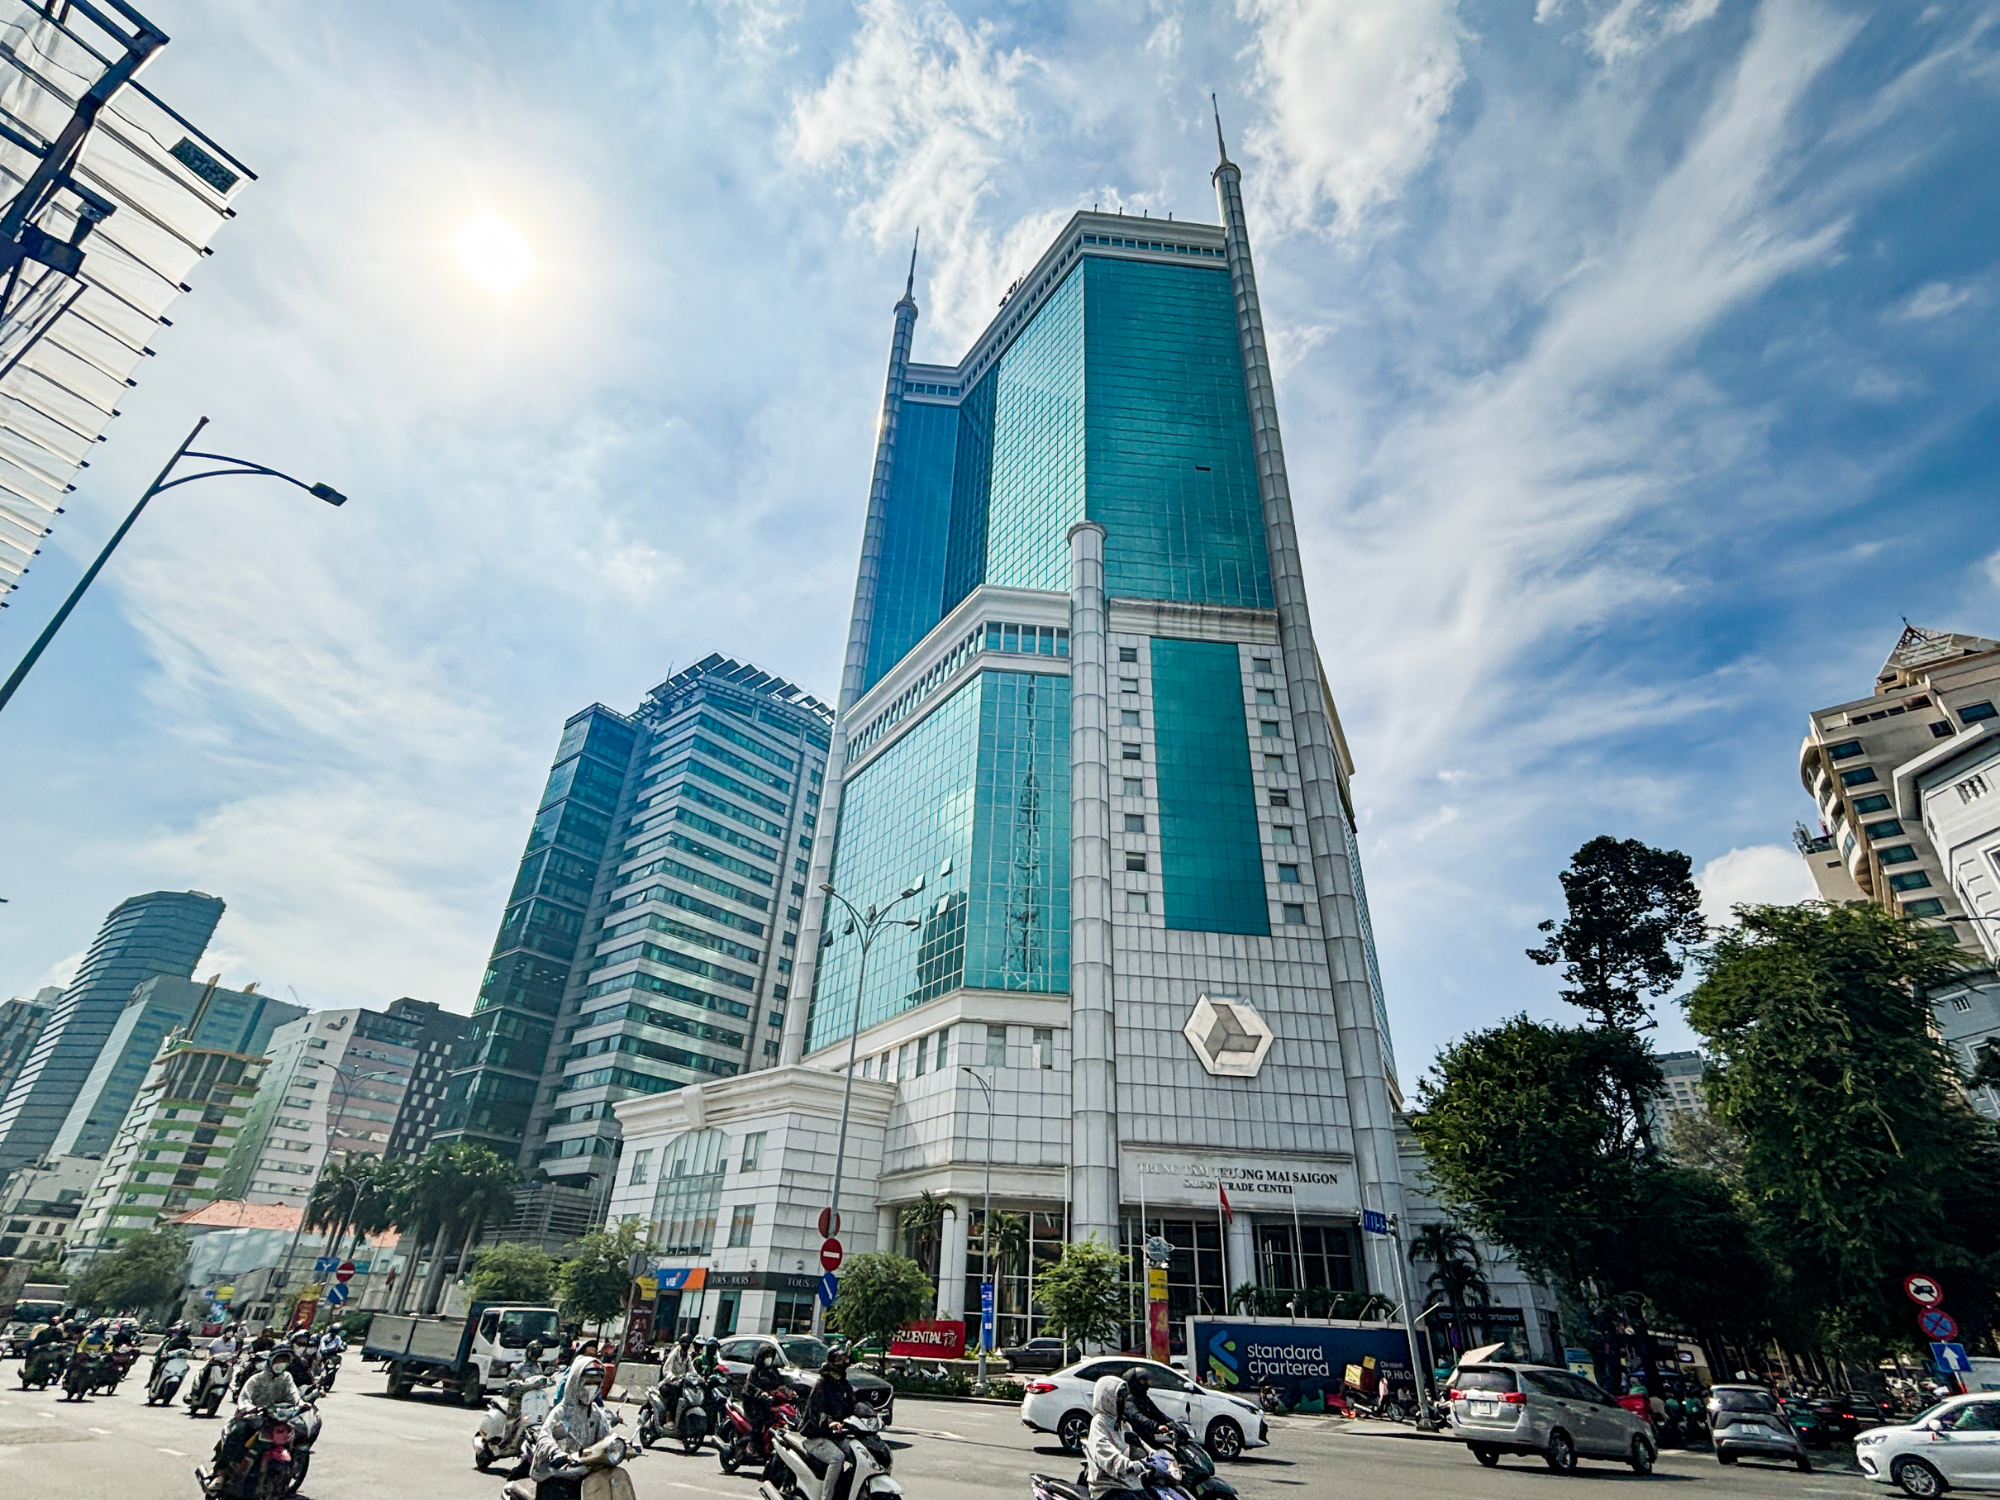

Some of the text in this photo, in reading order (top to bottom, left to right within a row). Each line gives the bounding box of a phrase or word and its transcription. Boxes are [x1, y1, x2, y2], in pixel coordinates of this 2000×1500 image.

[1292, 1171, 1338, 1185] SAIGON
[787, 1277, 810, 1288] TOUS
[1247, 1342, 1323, 1360] standard
[1248, 1358, 1330, 1377] chartered
